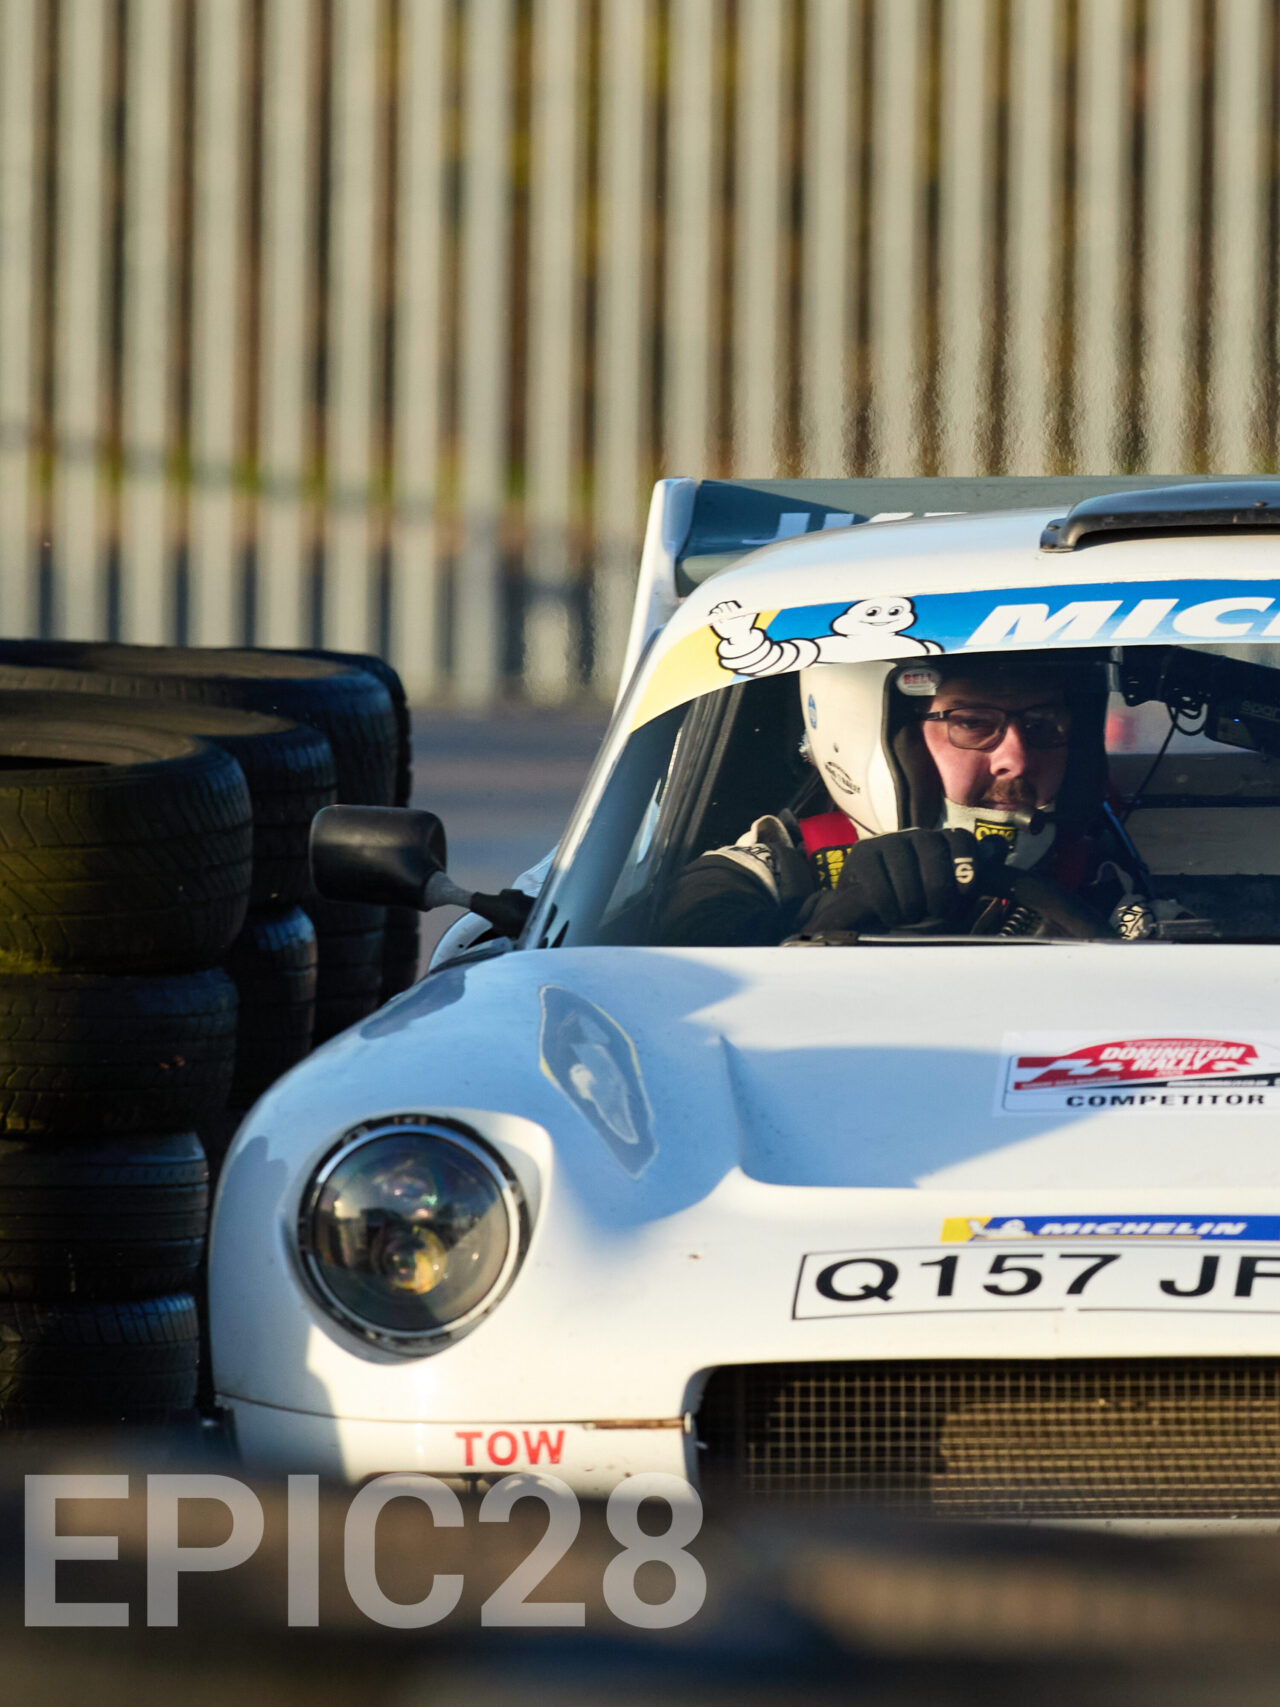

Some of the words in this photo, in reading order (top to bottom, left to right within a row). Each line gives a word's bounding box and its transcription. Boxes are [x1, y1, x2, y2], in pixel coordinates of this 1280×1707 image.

[1100, 1046, 1246, 1061] DONINGTON
[1131, 1058, 1207, 1071] RALLY
[1066, 1094, 1266, 1108] COMPETITOR
[1038, 1221, 1247, 1236] MICHELIN
[815, 1253, 1120, 1302] Q157
[456, 1430, 565, 1466] TOW
